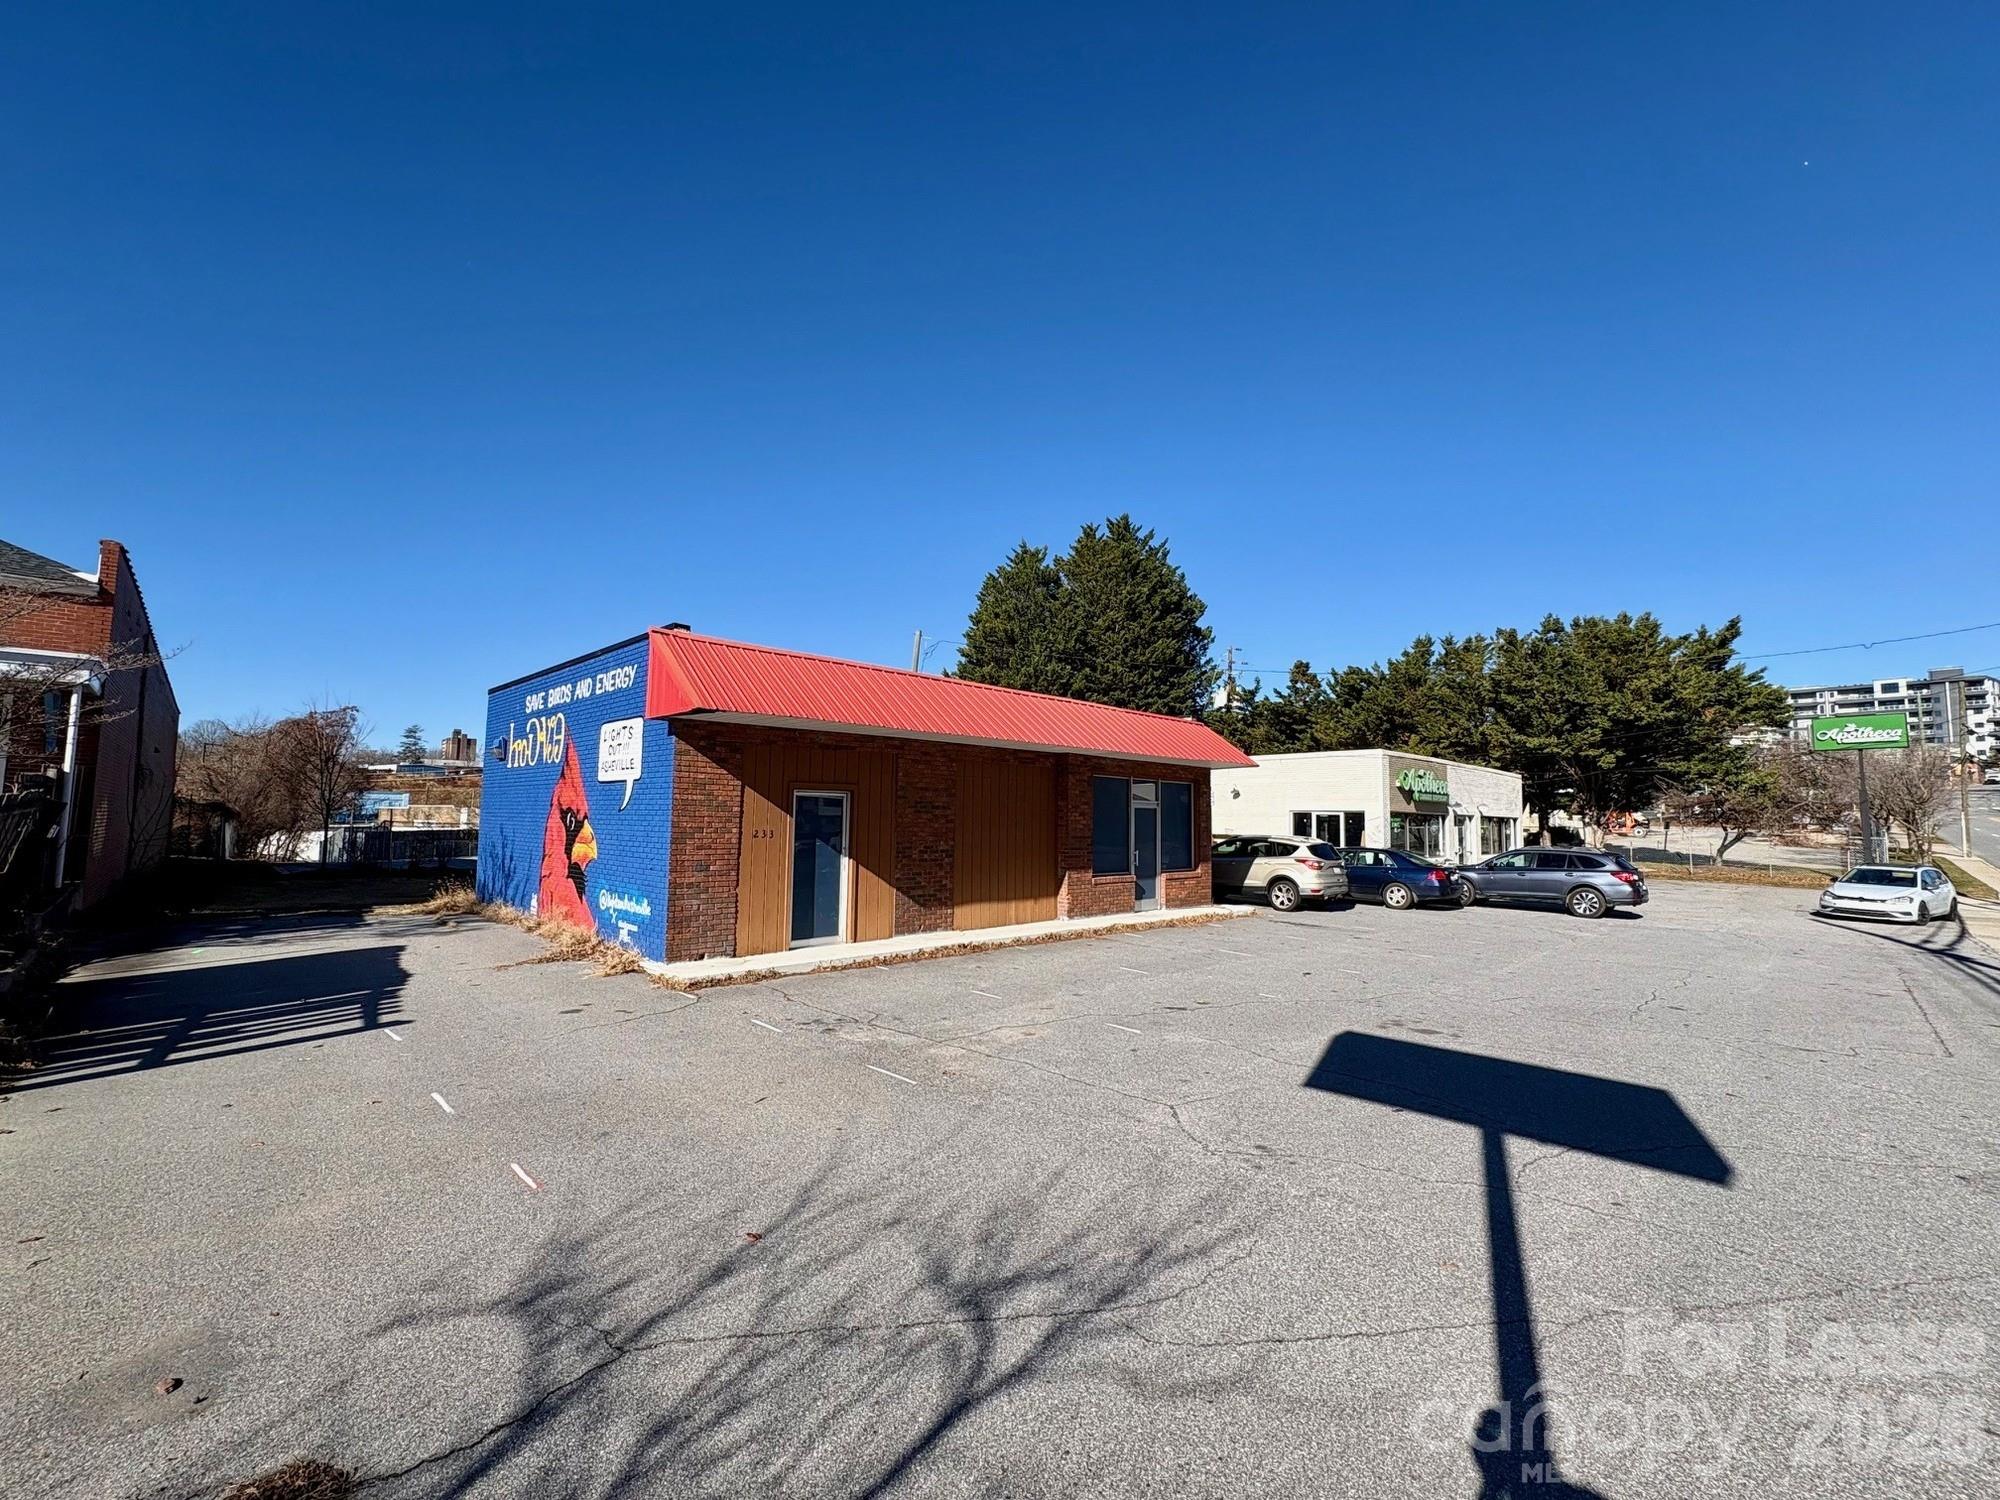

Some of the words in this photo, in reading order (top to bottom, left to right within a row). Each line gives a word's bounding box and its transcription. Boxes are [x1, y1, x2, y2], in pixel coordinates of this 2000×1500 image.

[525, 692, 545, 713] SAVE
[547, 684, 573, 708] BIRDS
[574, 677, 593, 700] AND
[595, 664, 638, 695] ENERGY
[603, 725, 634, 742] LIGHTS
[1816, 723, 1903, 744] Apotheca
[601, 758, 635, 773] ASHEVILLE
[753, 829, 774, 839] 233
